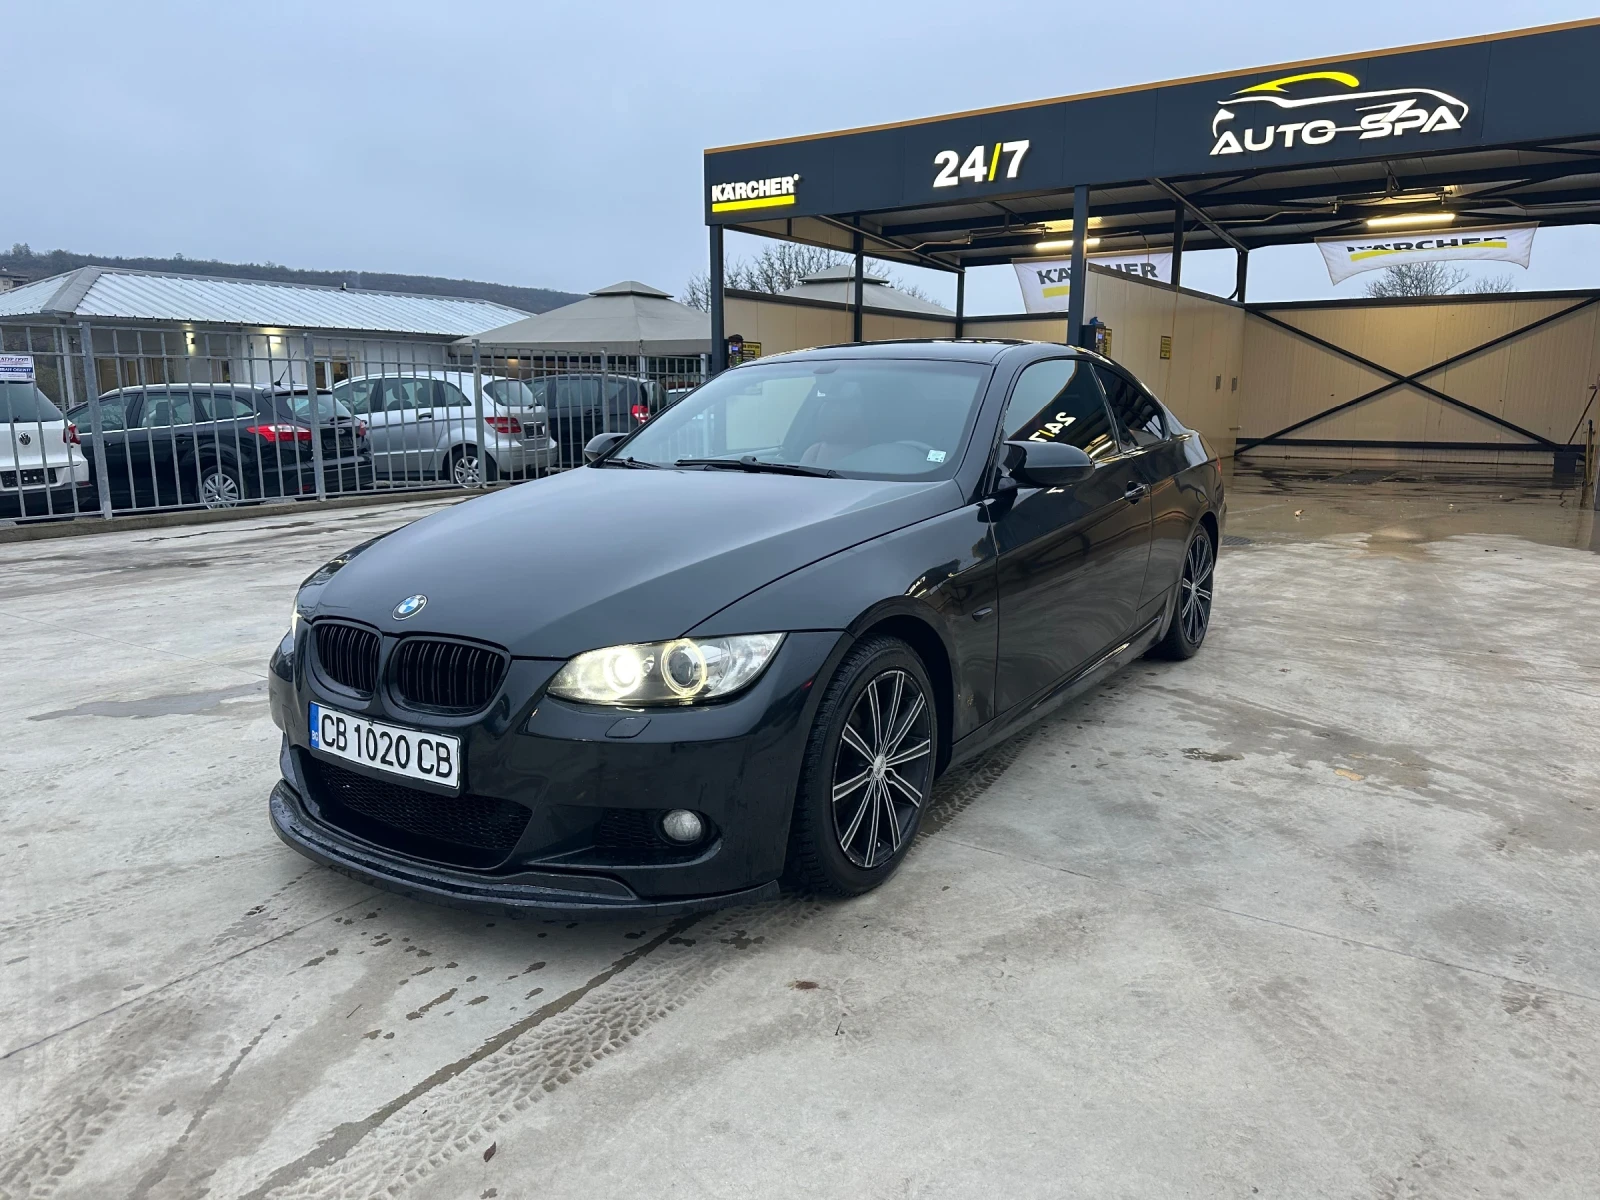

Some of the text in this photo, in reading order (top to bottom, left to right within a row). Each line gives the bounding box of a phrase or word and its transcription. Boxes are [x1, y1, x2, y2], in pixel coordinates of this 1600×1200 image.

[933, 140, 1029, 187] 24/7
[321, 714, 452, 778] CB 1020 CB
